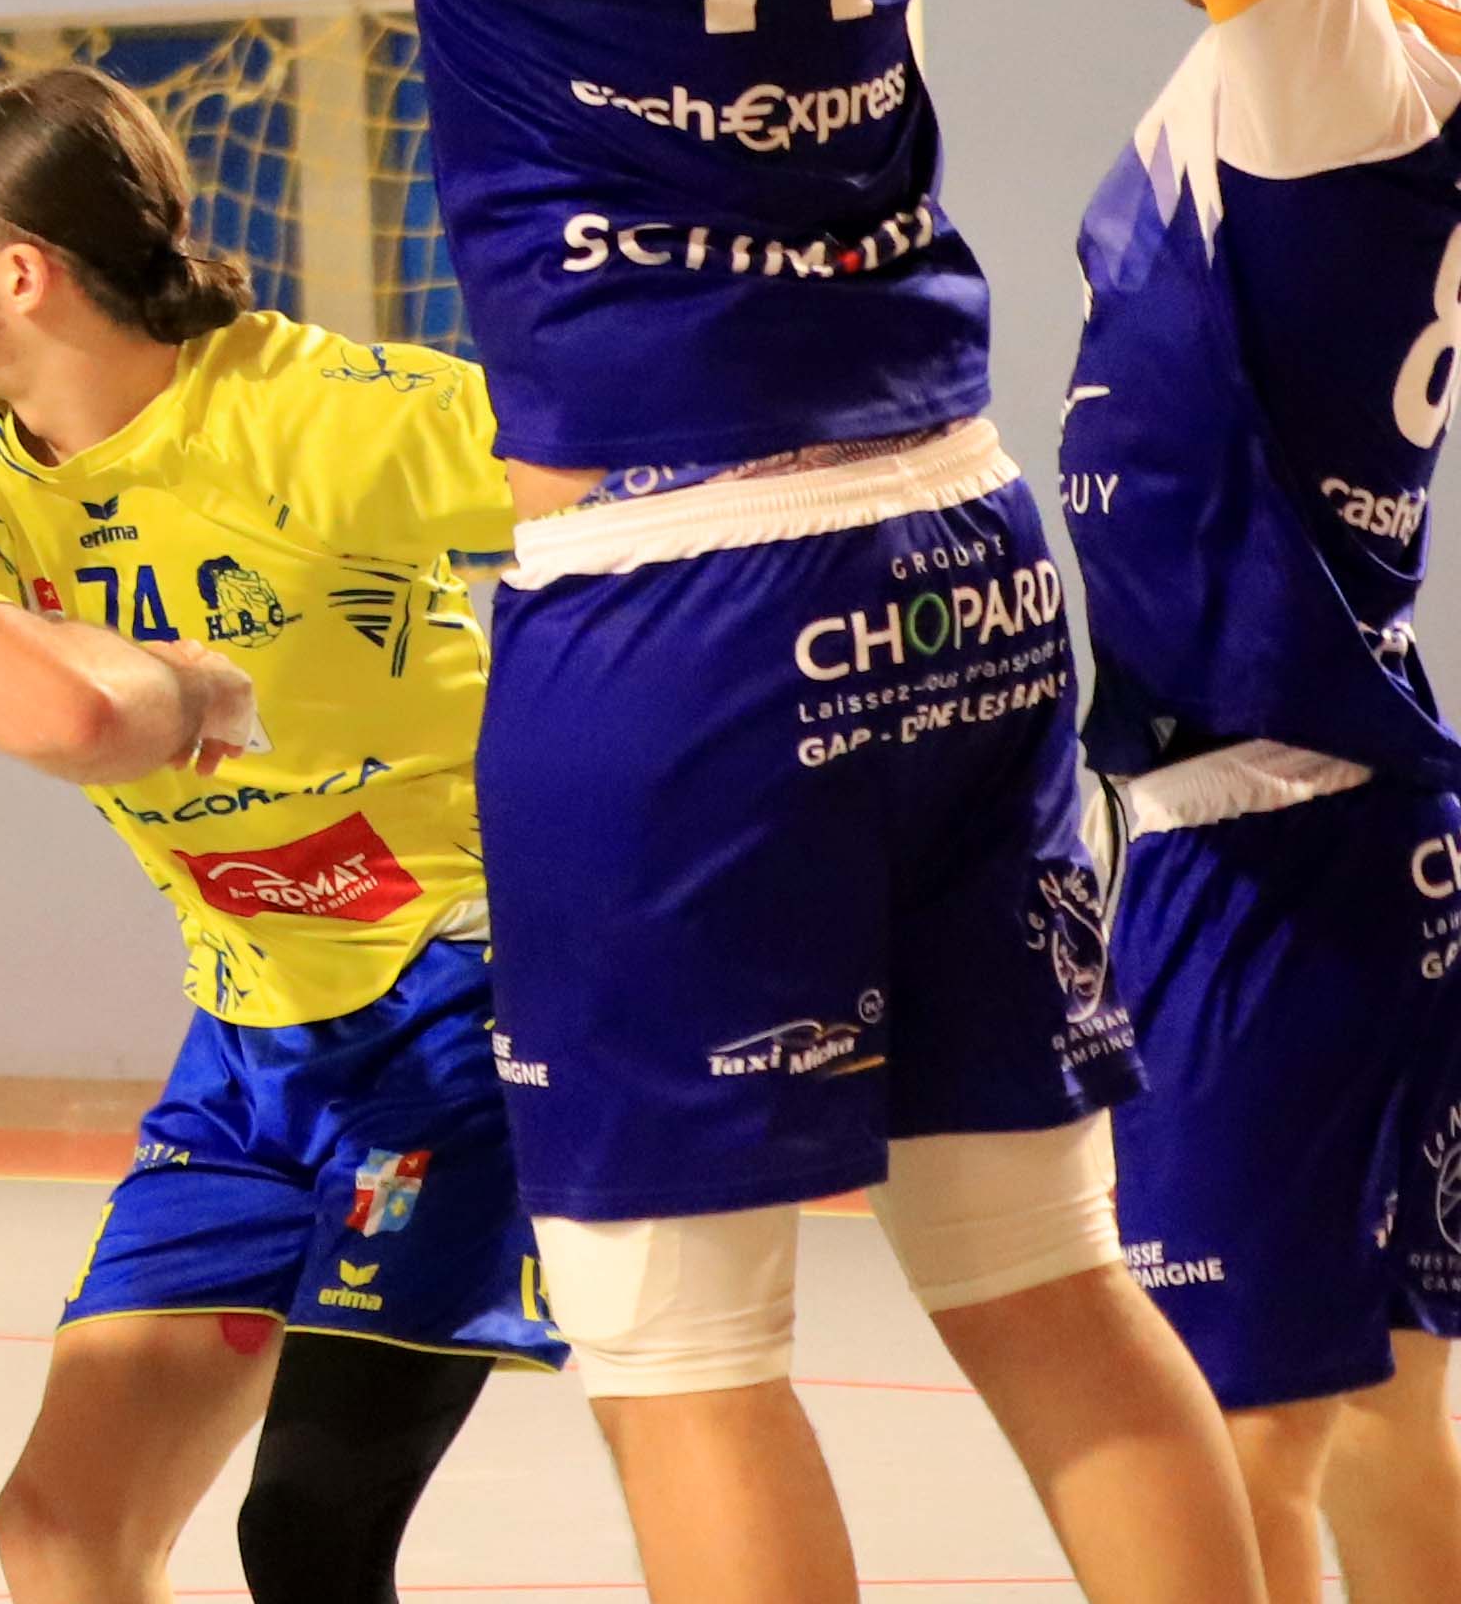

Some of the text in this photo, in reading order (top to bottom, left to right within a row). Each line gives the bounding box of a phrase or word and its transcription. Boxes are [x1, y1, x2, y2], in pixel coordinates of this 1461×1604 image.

[79, 525, 139, 548] erima
[891, 534, 1006, 580] GROUPE
[75, 564, 181, 643] 74
[794, 558, 1063, 682] CHOPARD
[797, 727, 872, 768] GAP
[708, 1044, 783, 1077] Taxi
[317, 1285, 383, 1312] erima
